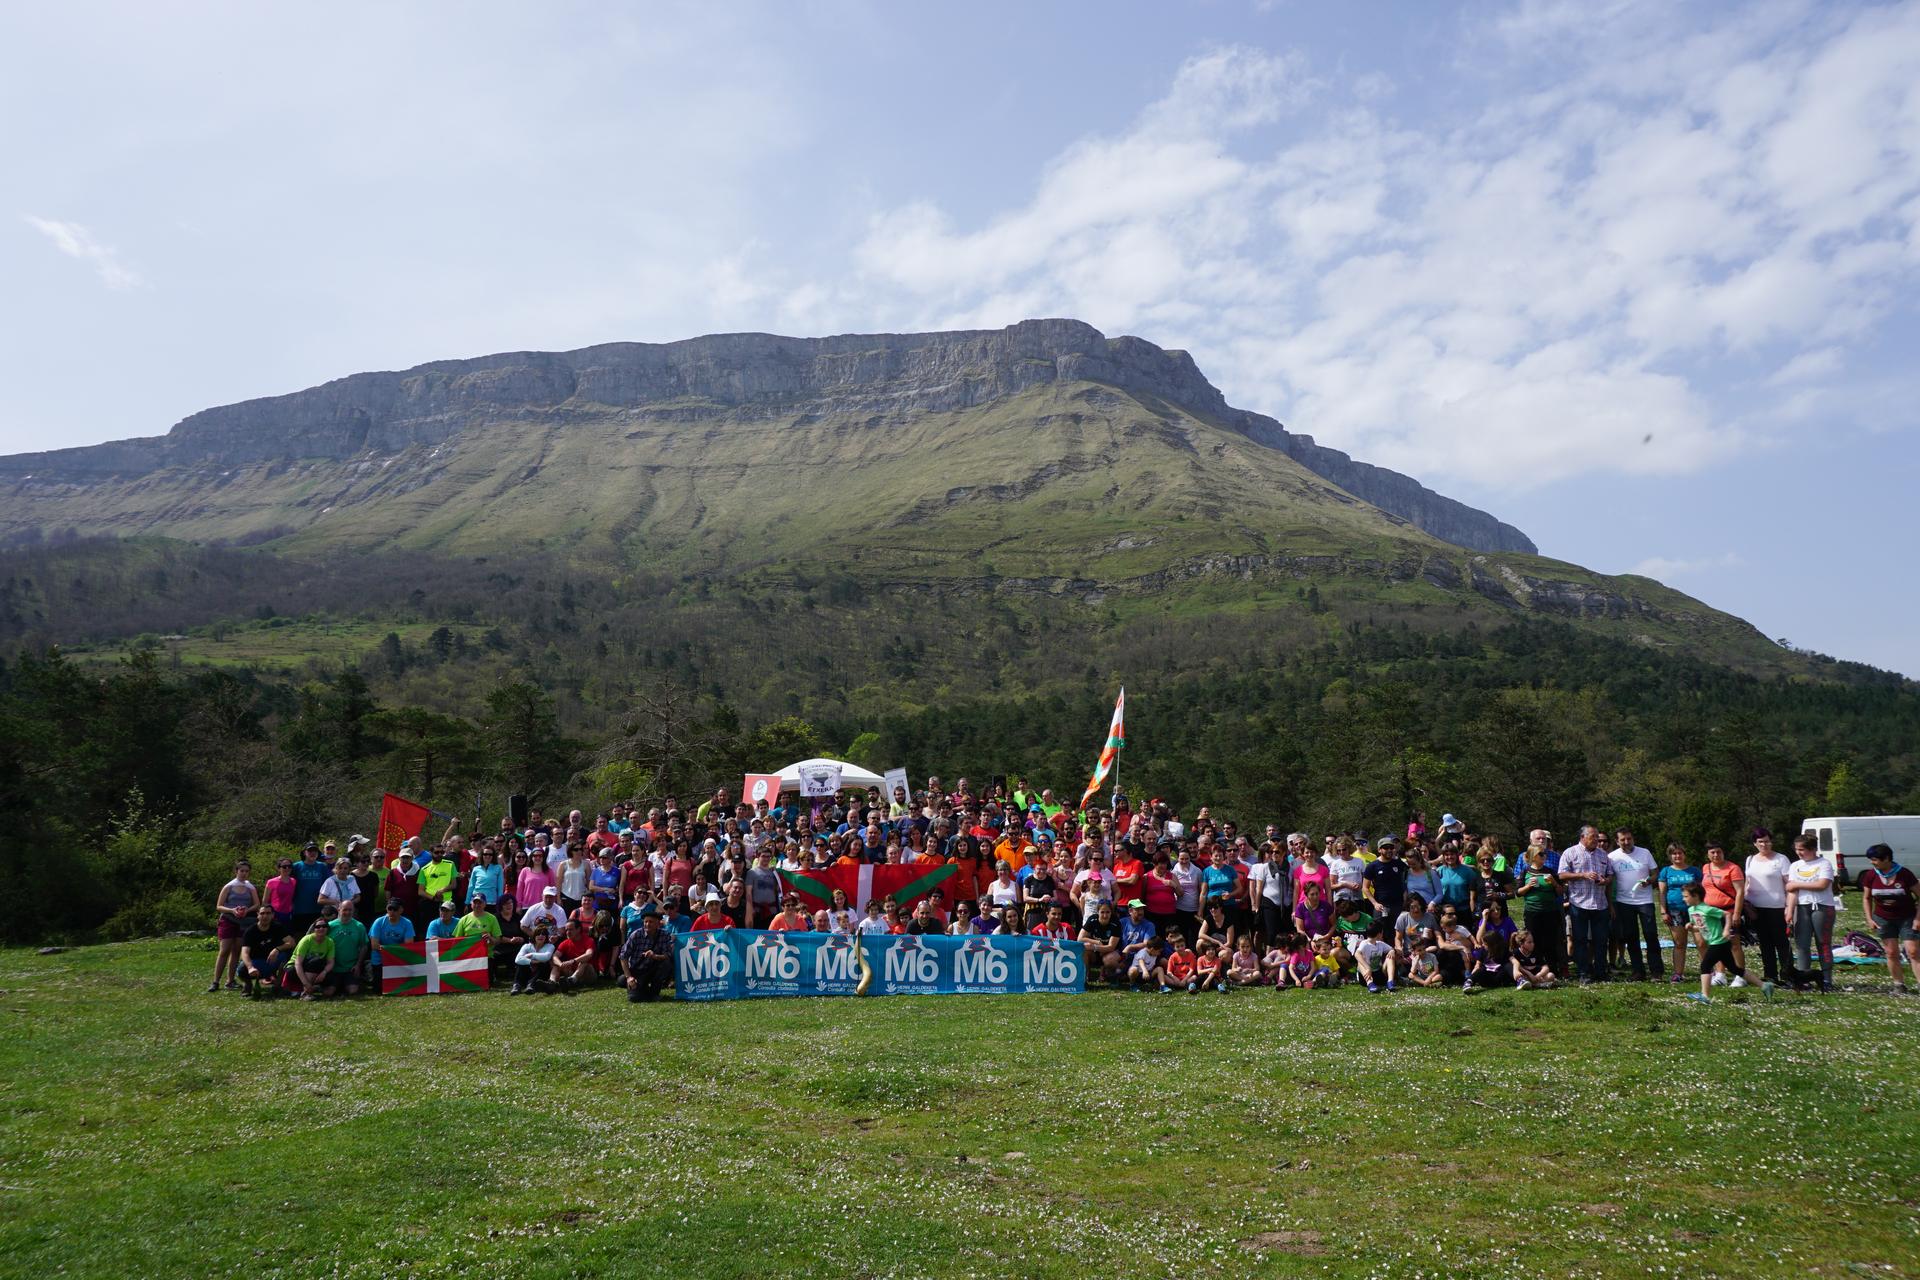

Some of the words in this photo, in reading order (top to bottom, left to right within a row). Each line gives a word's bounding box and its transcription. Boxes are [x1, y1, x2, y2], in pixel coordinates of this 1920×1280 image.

[680, 943, 731, 982] M6
[745, 944, 801, 980] M6
[815, 946, 870, 981] M6
[885, 947, 940, 983] M6
[953, 948, 1008, 984] M6
[1023, 949, 1078, 984] M6
